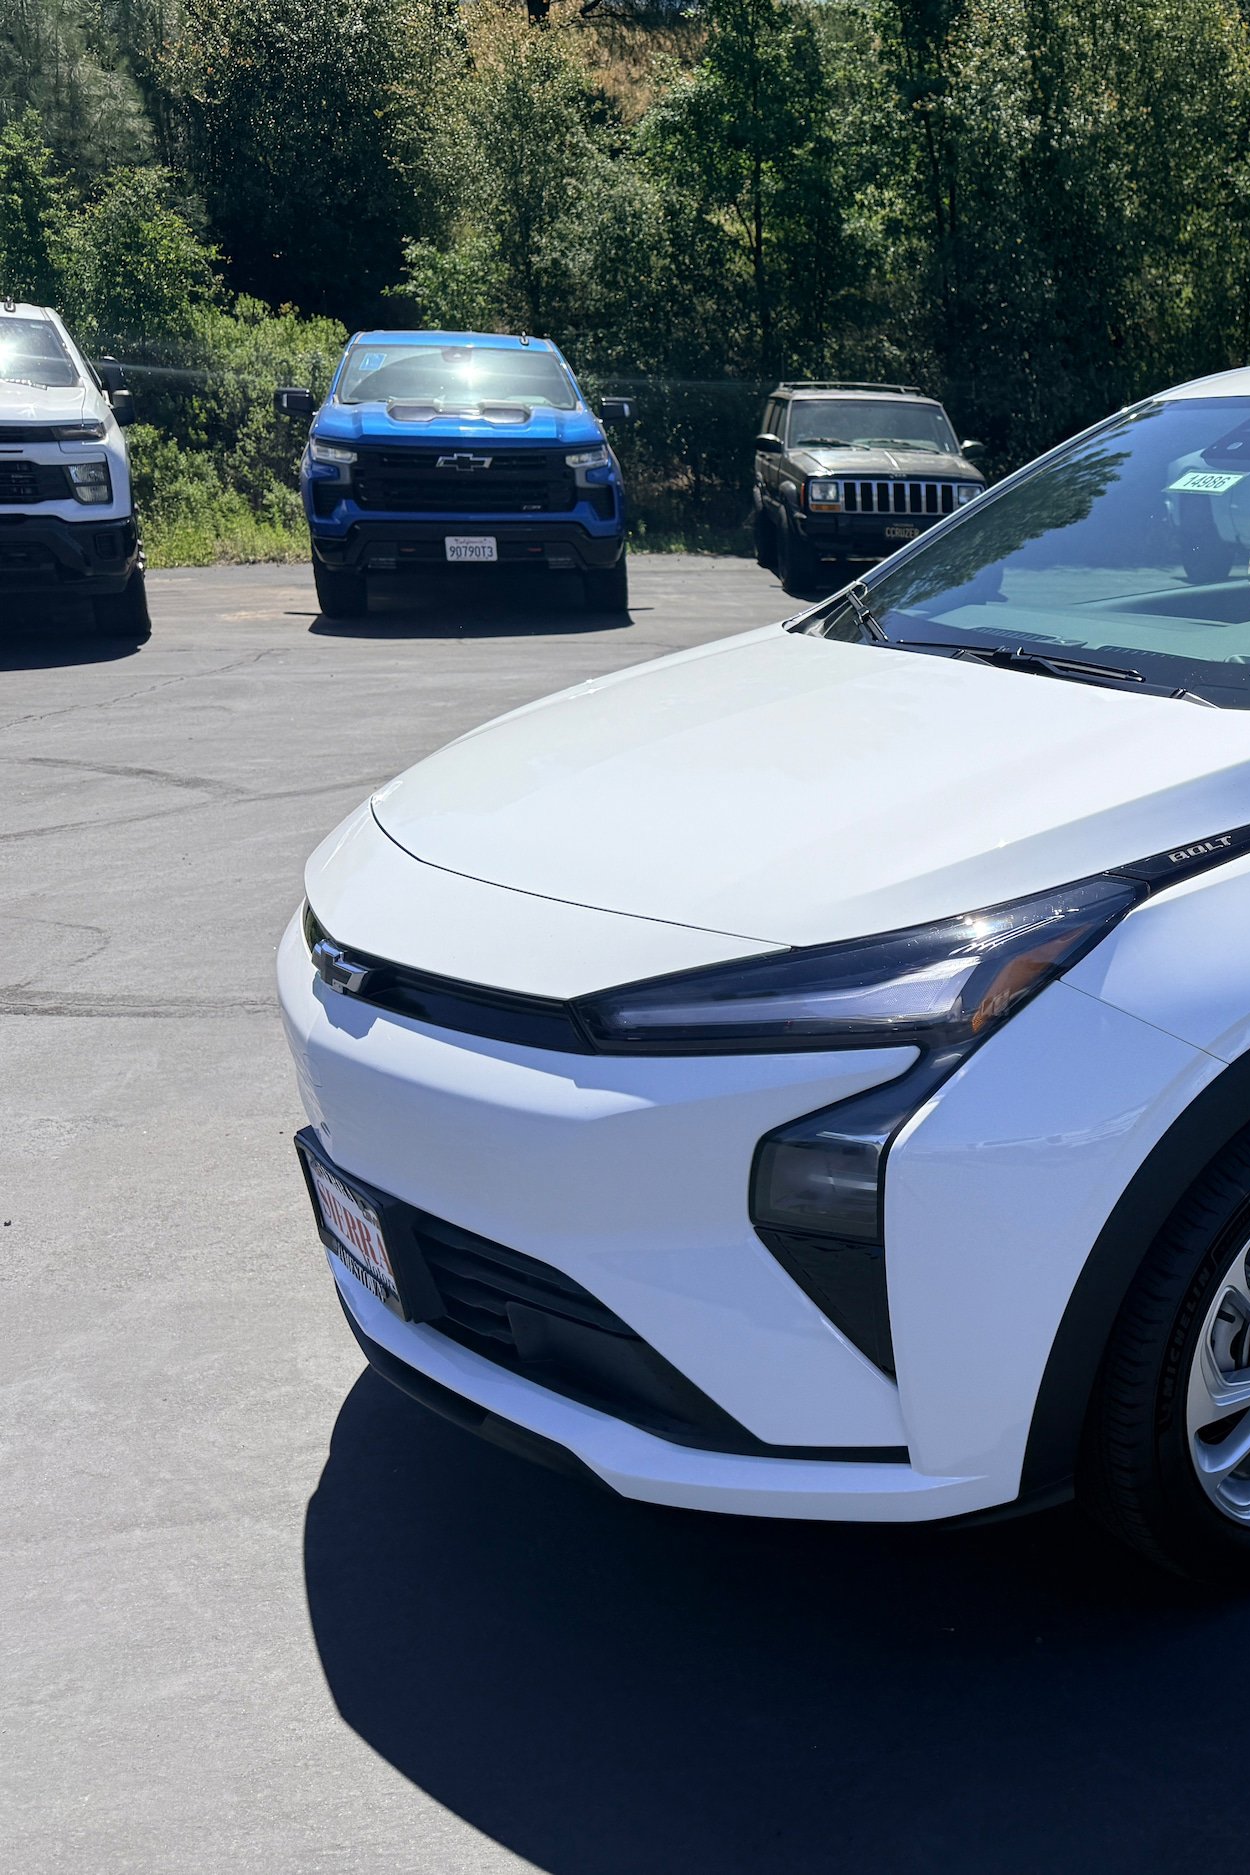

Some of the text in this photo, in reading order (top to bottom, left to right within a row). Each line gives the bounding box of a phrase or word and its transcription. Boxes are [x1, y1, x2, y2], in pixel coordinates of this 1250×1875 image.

[1183, 474, 1231, 489] 14986
[449, 545, 494, 558] 90790T3
[1168, 835, 1232, 863] BOLT
[316, 1179, 395, 1277] SIERRA
[1162, 1265, 1211, 1398] MICHELIN
